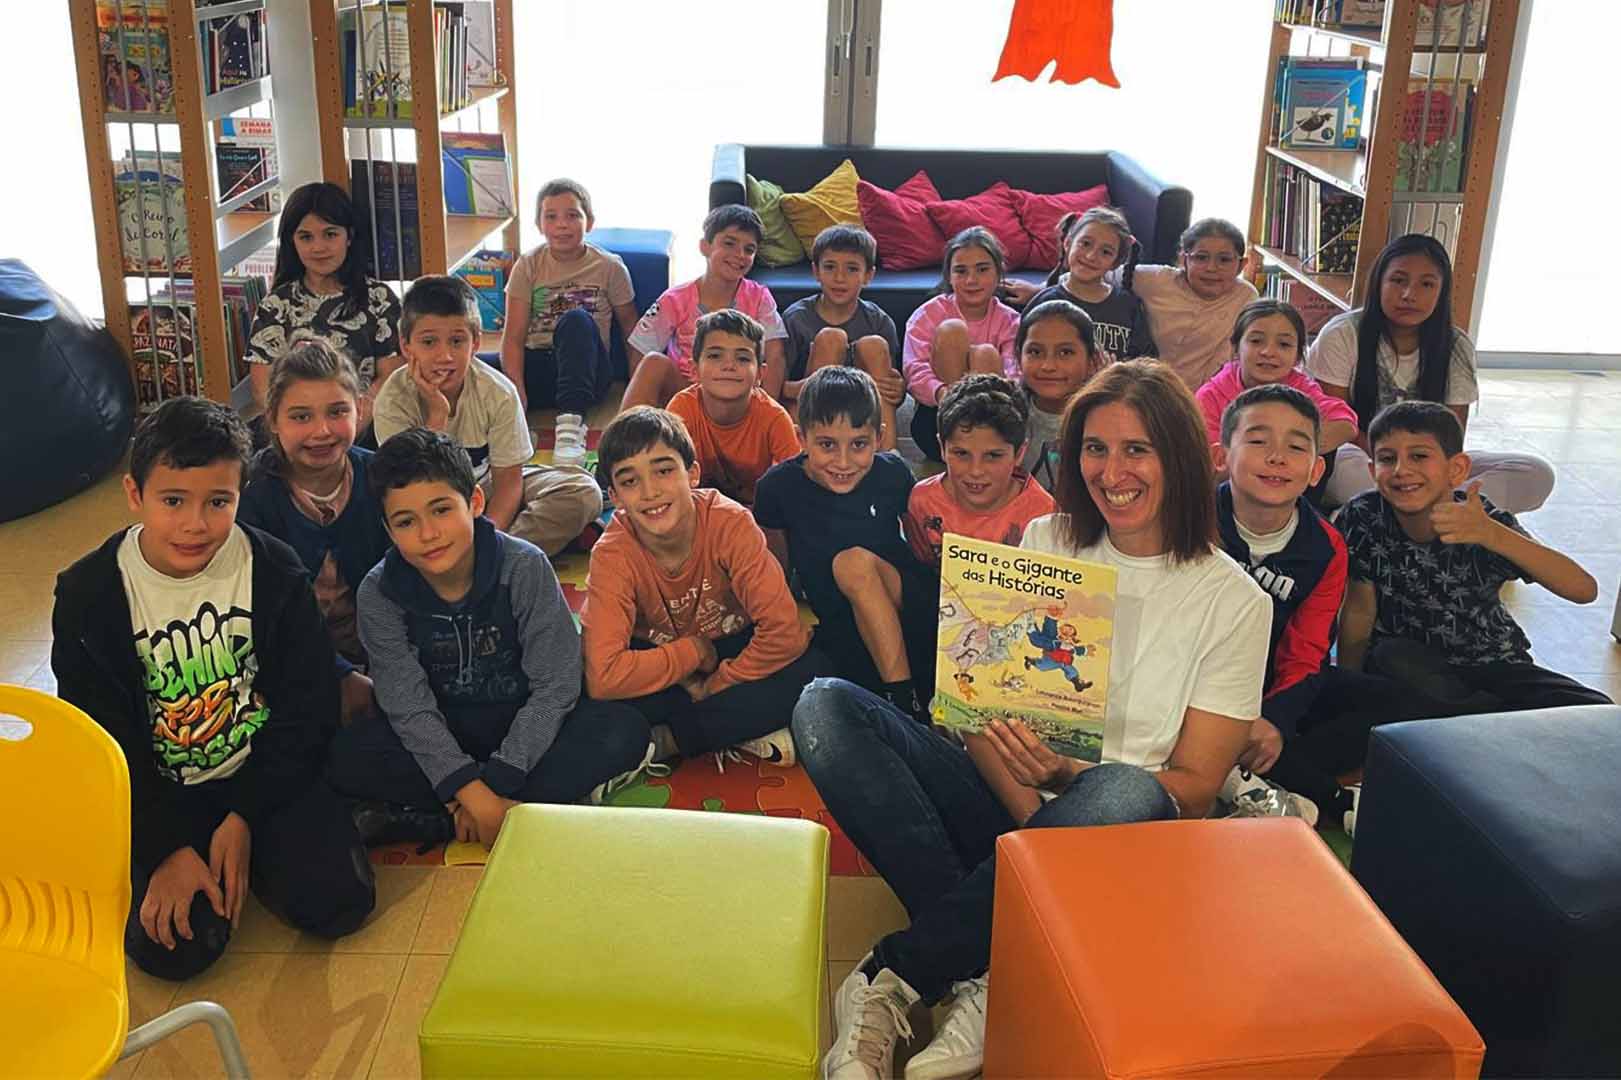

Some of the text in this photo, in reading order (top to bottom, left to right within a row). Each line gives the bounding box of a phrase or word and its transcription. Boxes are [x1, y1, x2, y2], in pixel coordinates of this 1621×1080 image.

[948, 544, 1083, 585] Sara e o Gigante
[962, 568, 1066, 600] das Histórias
